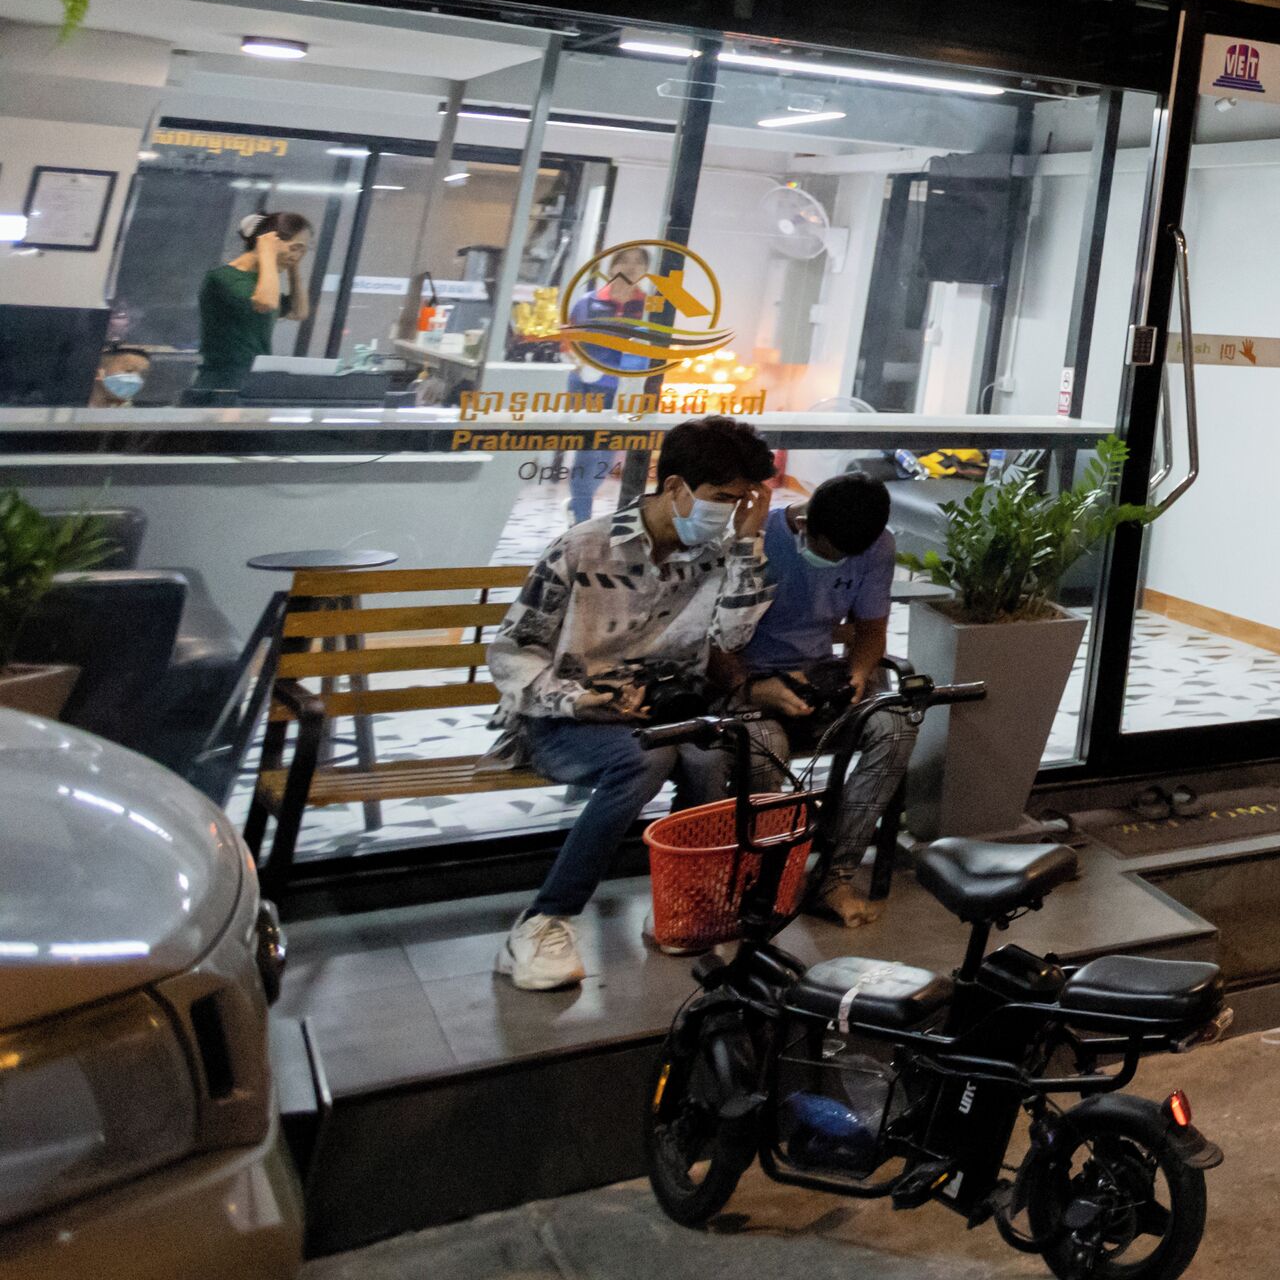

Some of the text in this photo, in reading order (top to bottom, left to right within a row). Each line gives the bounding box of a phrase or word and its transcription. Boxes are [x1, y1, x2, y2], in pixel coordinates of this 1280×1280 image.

[1225, 53, 1259, 80] VET
[451, 429, 664, 452] Pratunam Famil
[517, 460, 585, 486] Open
